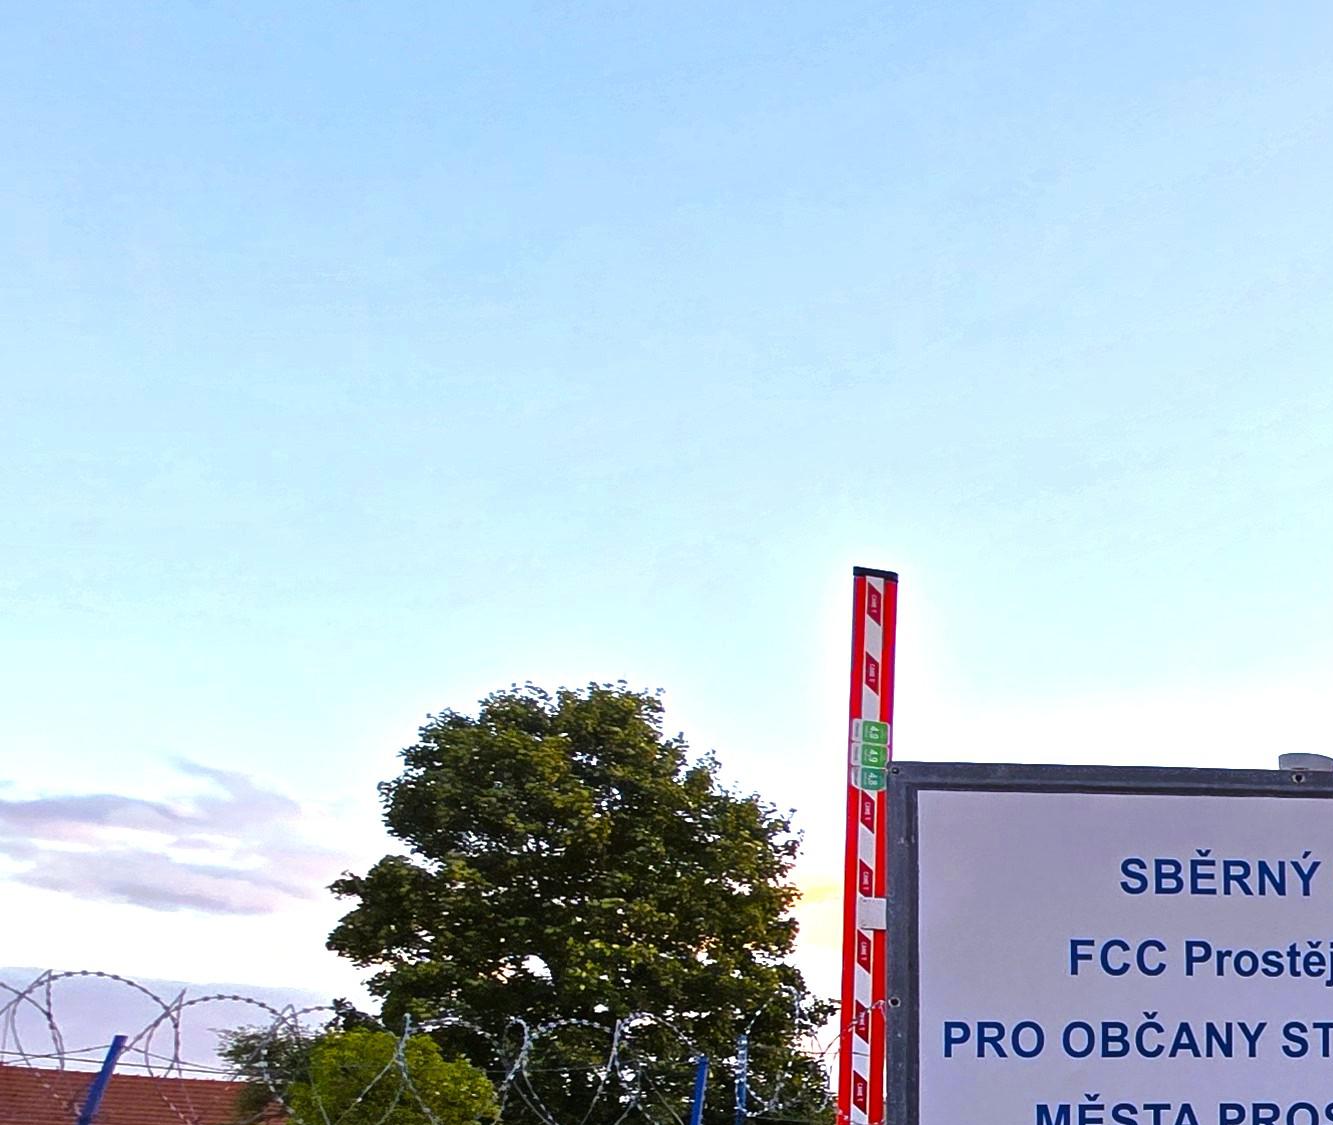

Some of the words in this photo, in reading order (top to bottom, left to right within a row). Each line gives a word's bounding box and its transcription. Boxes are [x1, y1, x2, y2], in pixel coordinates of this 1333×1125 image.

[1120, 849, 1322, 897] SBĚRNÝ
[1070, 938, 1167, 977] FCC
[943, 1020, 1045, 1059] PRO
[1062, 1011, 1268, 1059] OBČANY
